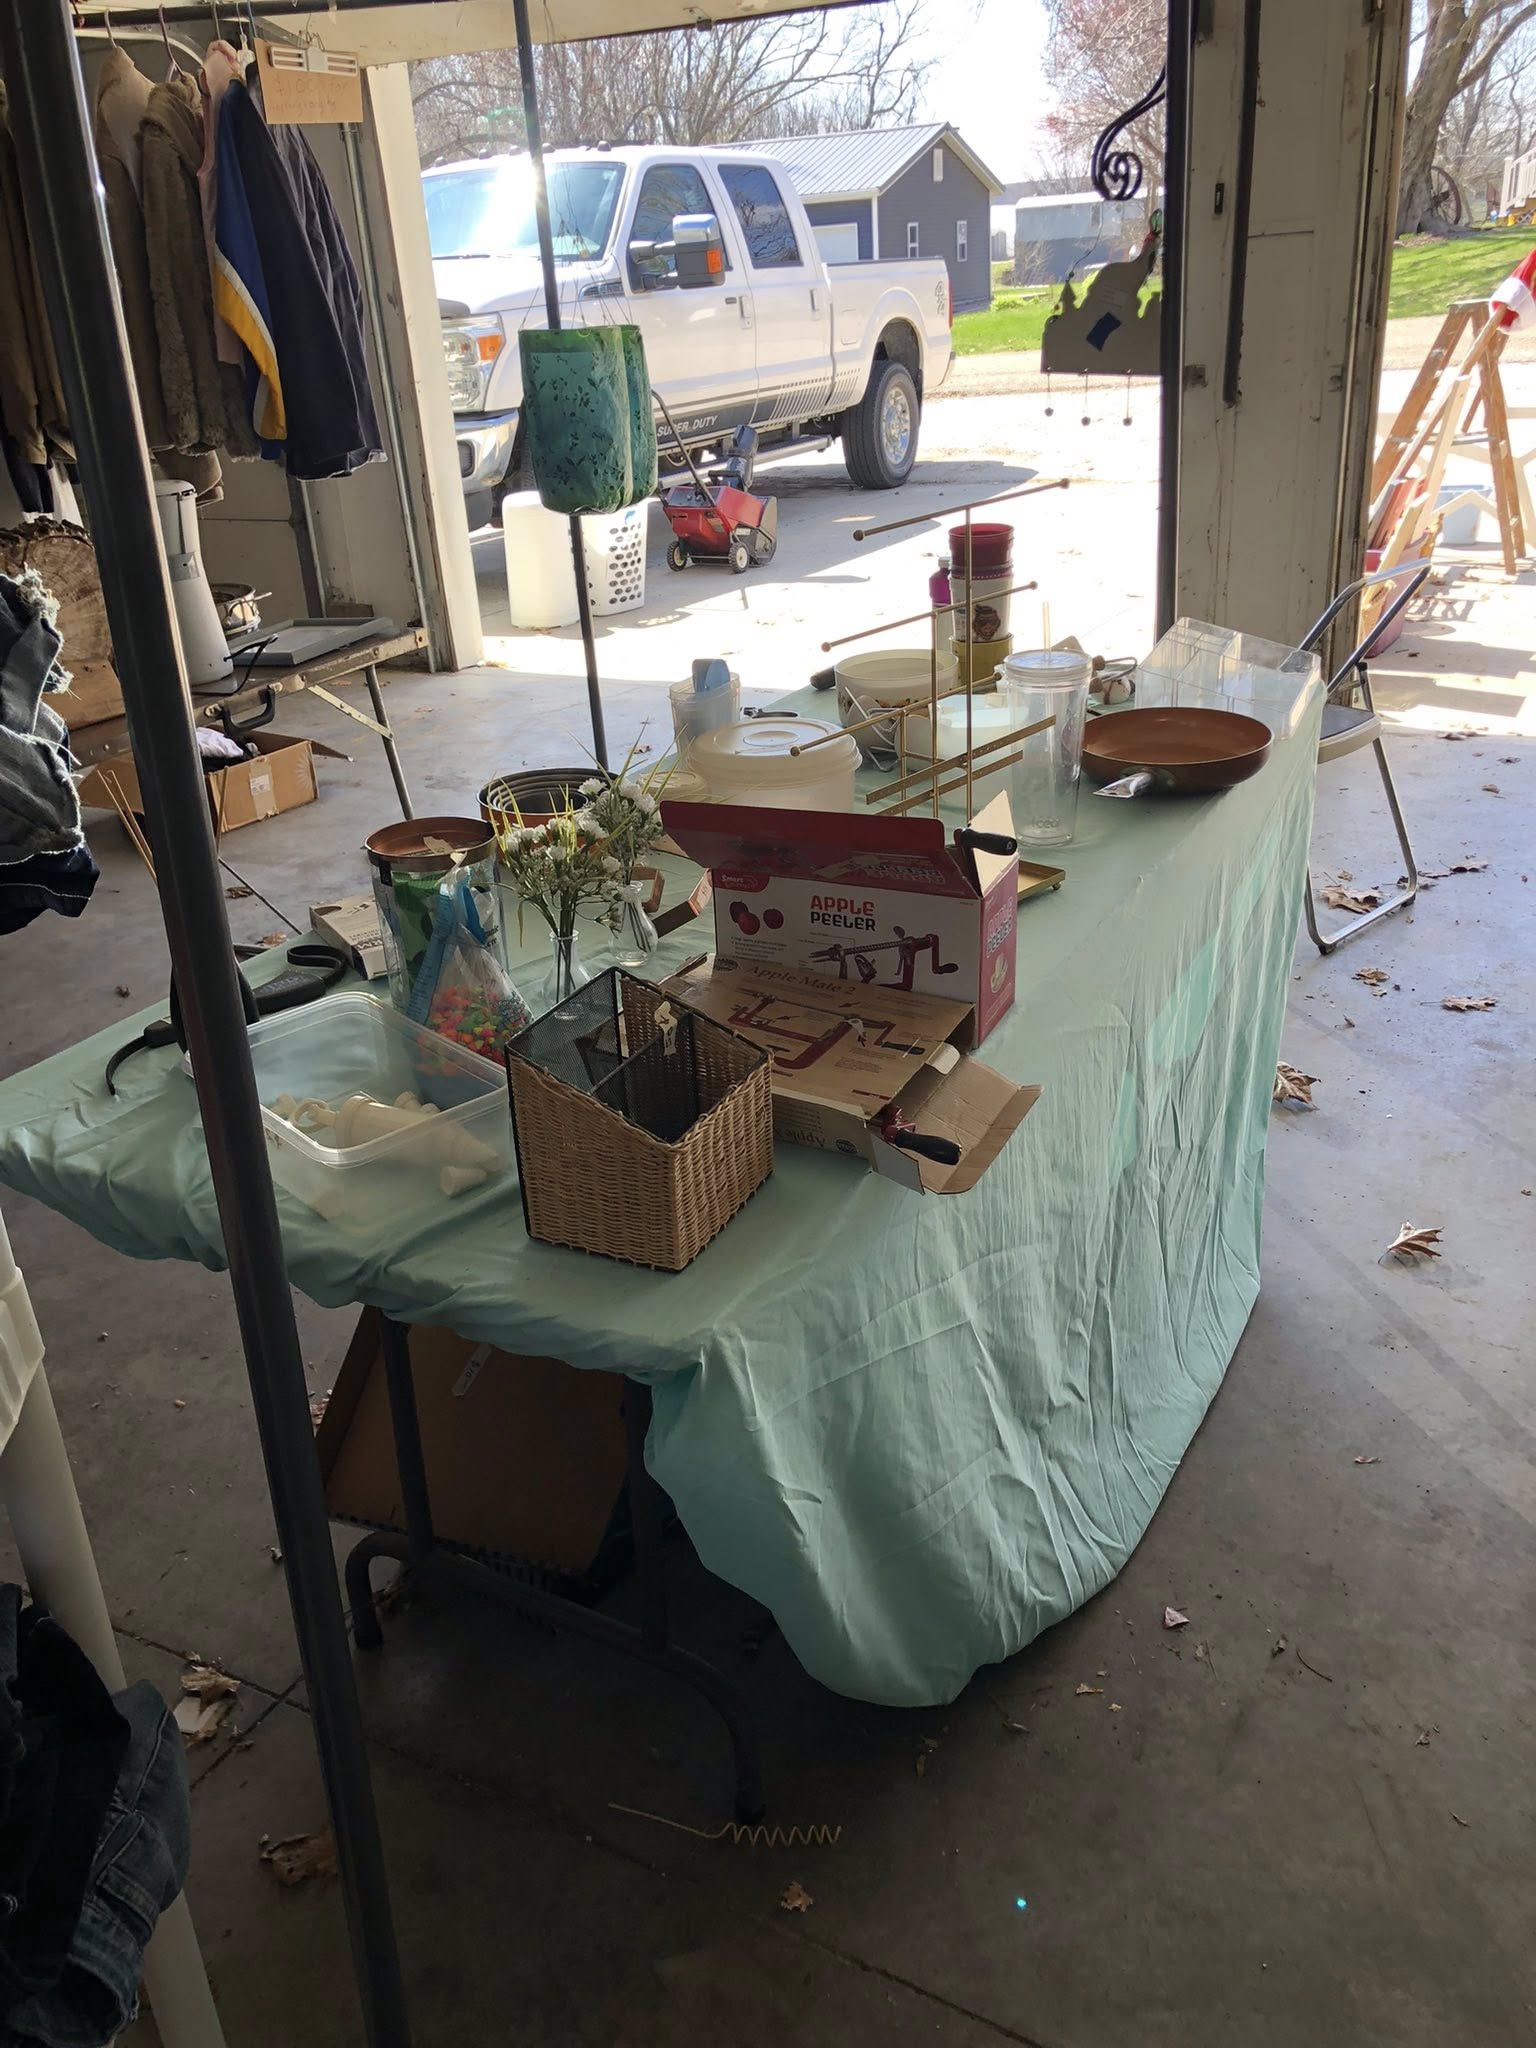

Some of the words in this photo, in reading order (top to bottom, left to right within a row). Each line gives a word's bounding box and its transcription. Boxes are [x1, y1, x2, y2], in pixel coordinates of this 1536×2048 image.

[692, 415, 718, 430] DUTY
[810, 895, 875, 916] APPLE
[810, 911, 876, 932] PEELER
[747, 964, 797, 984] Apple
[798, 974, 842, 992] Mate
[844, 985, 857, 995] 2
